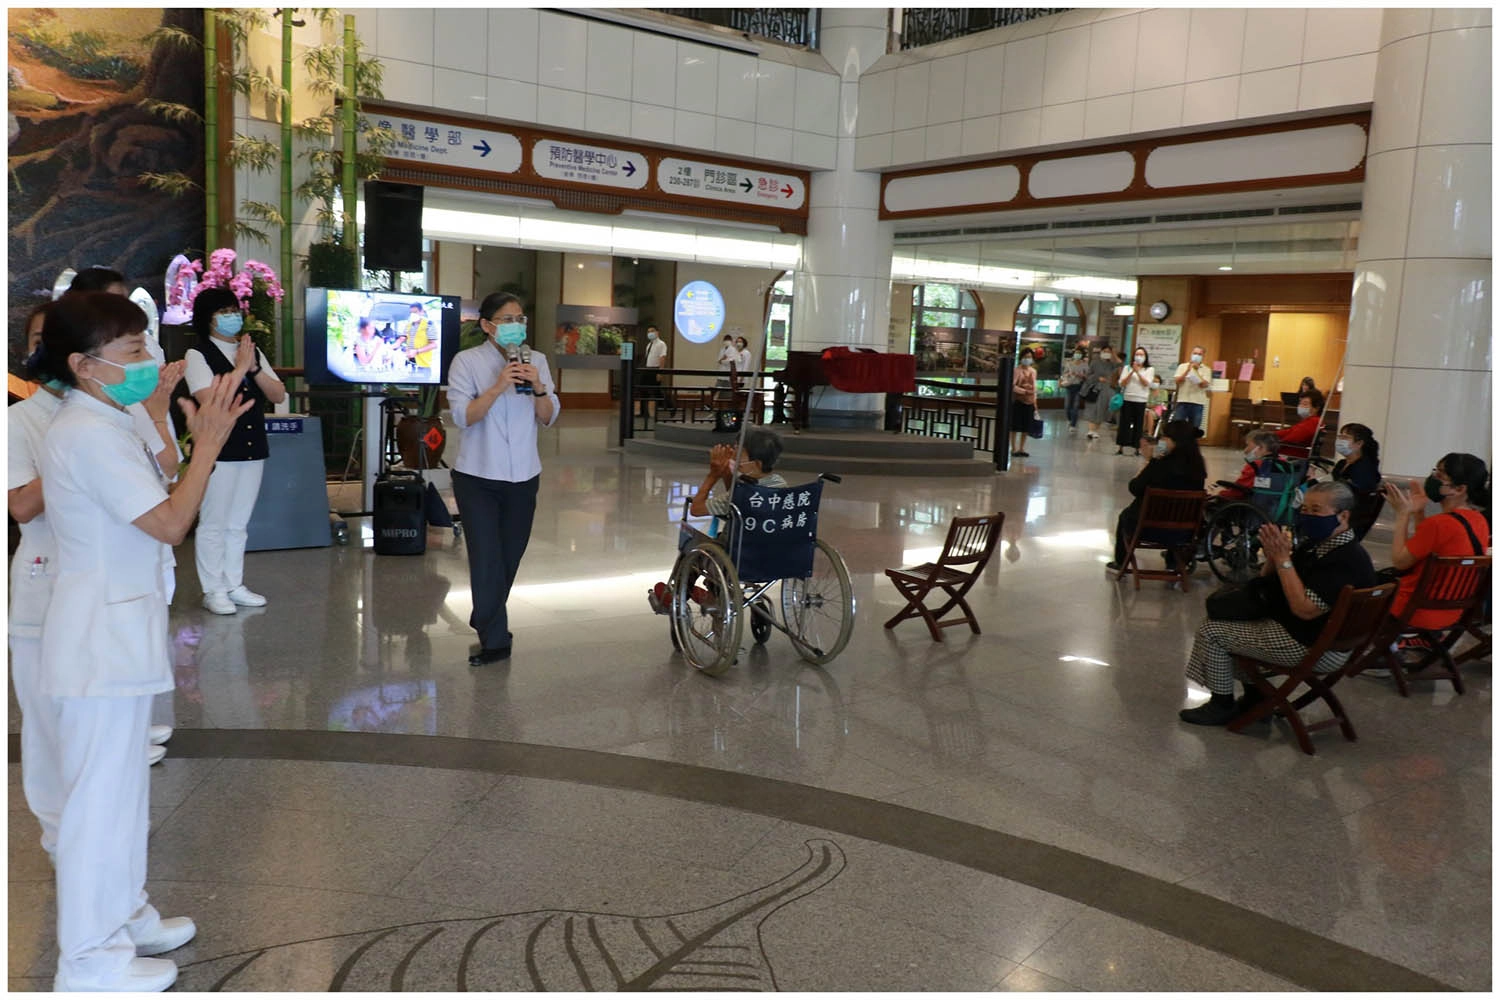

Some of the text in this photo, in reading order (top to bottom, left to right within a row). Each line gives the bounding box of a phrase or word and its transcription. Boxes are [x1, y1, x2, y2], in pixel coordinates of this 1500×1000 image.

[550, 146, 617, 168] 預防醫學中心
[704, 168, 737, 186] 門診區
[749, 490, 811, 511] 台中慈院
